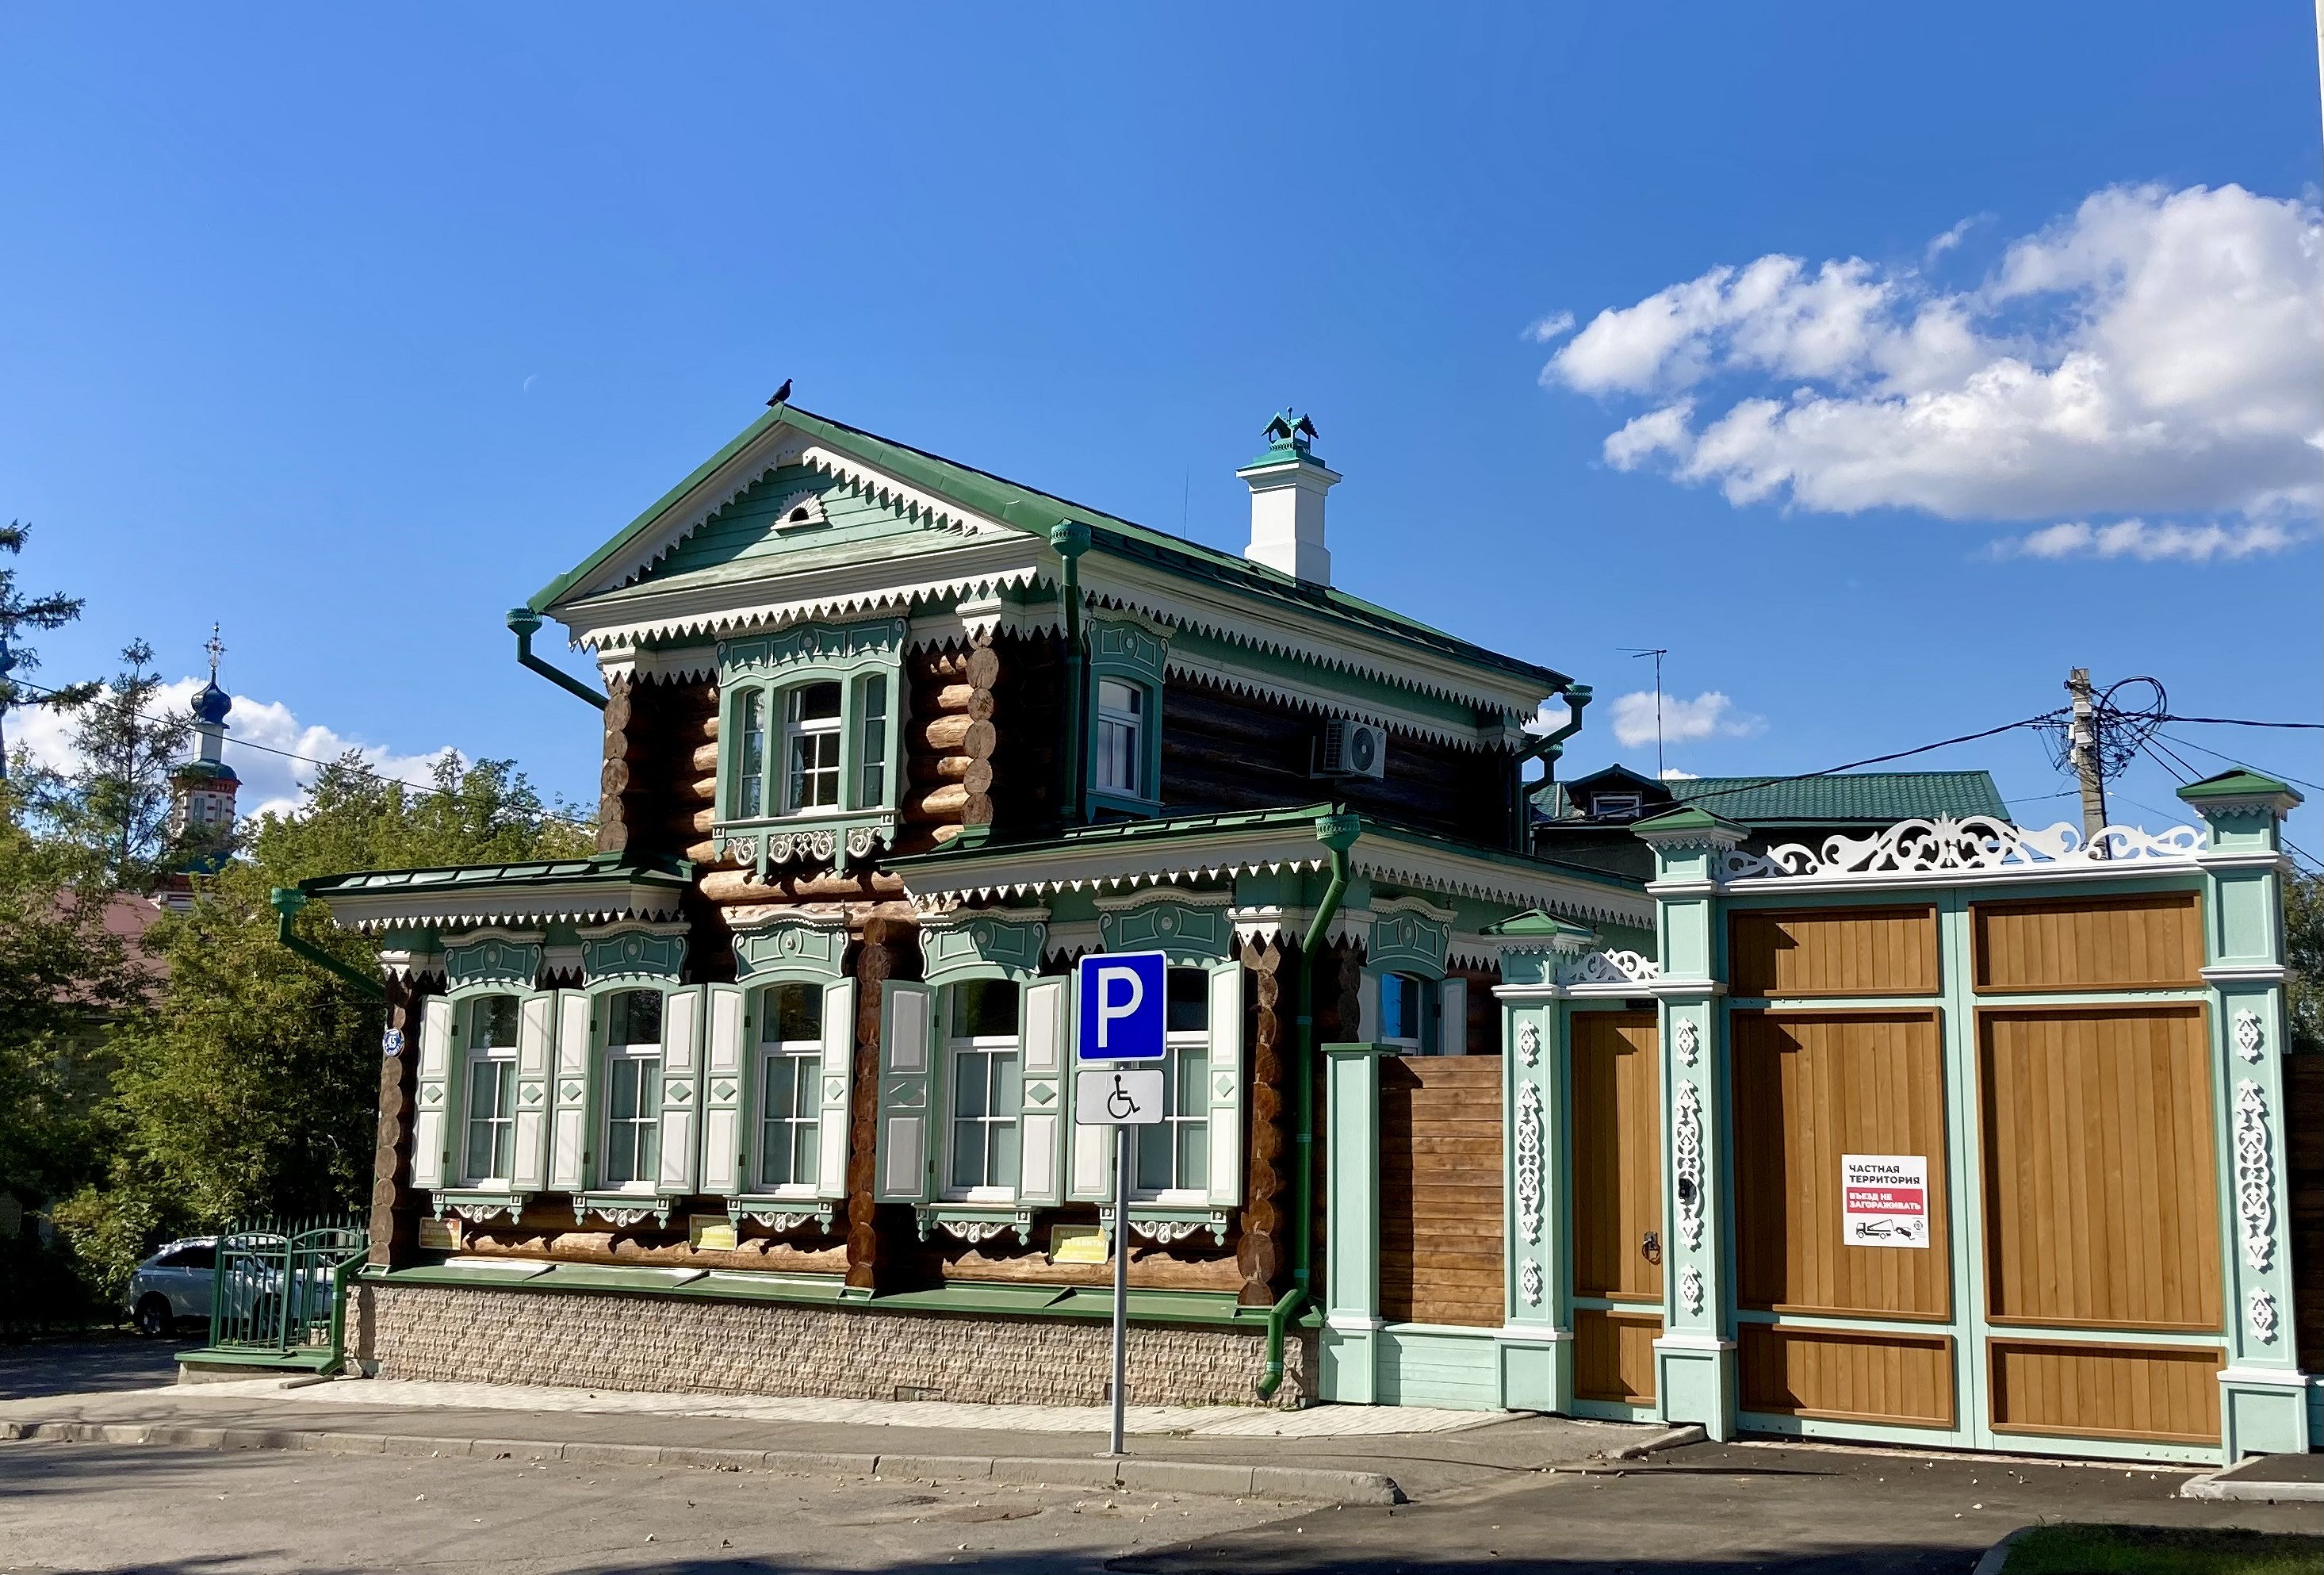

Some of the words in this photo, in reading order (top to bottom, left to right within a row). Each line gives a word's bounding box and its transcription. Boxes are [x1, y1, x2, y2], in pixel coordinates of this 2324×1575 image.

[1098, 967, 1143, 1048] P
[388, 1035, 396, 1048] 45
[1849, 1164, 1900, 1173] ЧАСТНАЯ
[1849, 1175, 1920, 1184] ТЕРРИТОРИЯ
[1849, 1201, 1921, 1210] ЗАГОРАЖИВАТЬ
